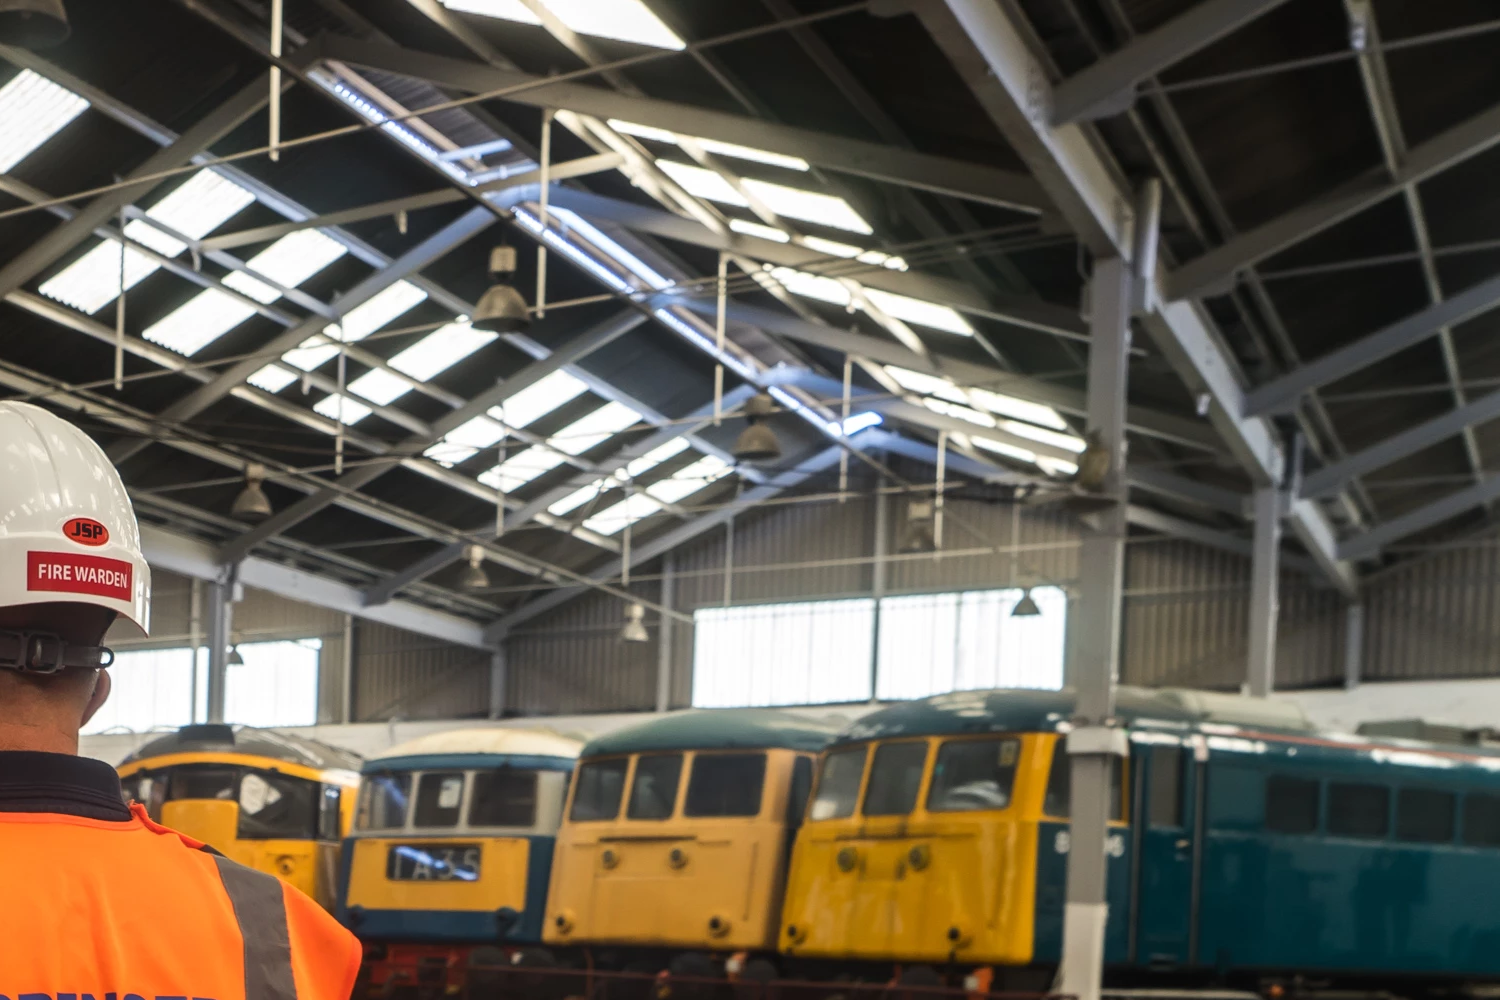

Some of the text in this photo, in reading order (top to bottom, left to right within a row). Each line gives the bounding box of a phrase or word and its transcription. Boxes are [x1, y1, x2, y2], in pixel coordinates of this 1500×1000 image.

[71, 522, 103, 539] JSP
[38, 563, 128, 589] FIRE WARDEN
